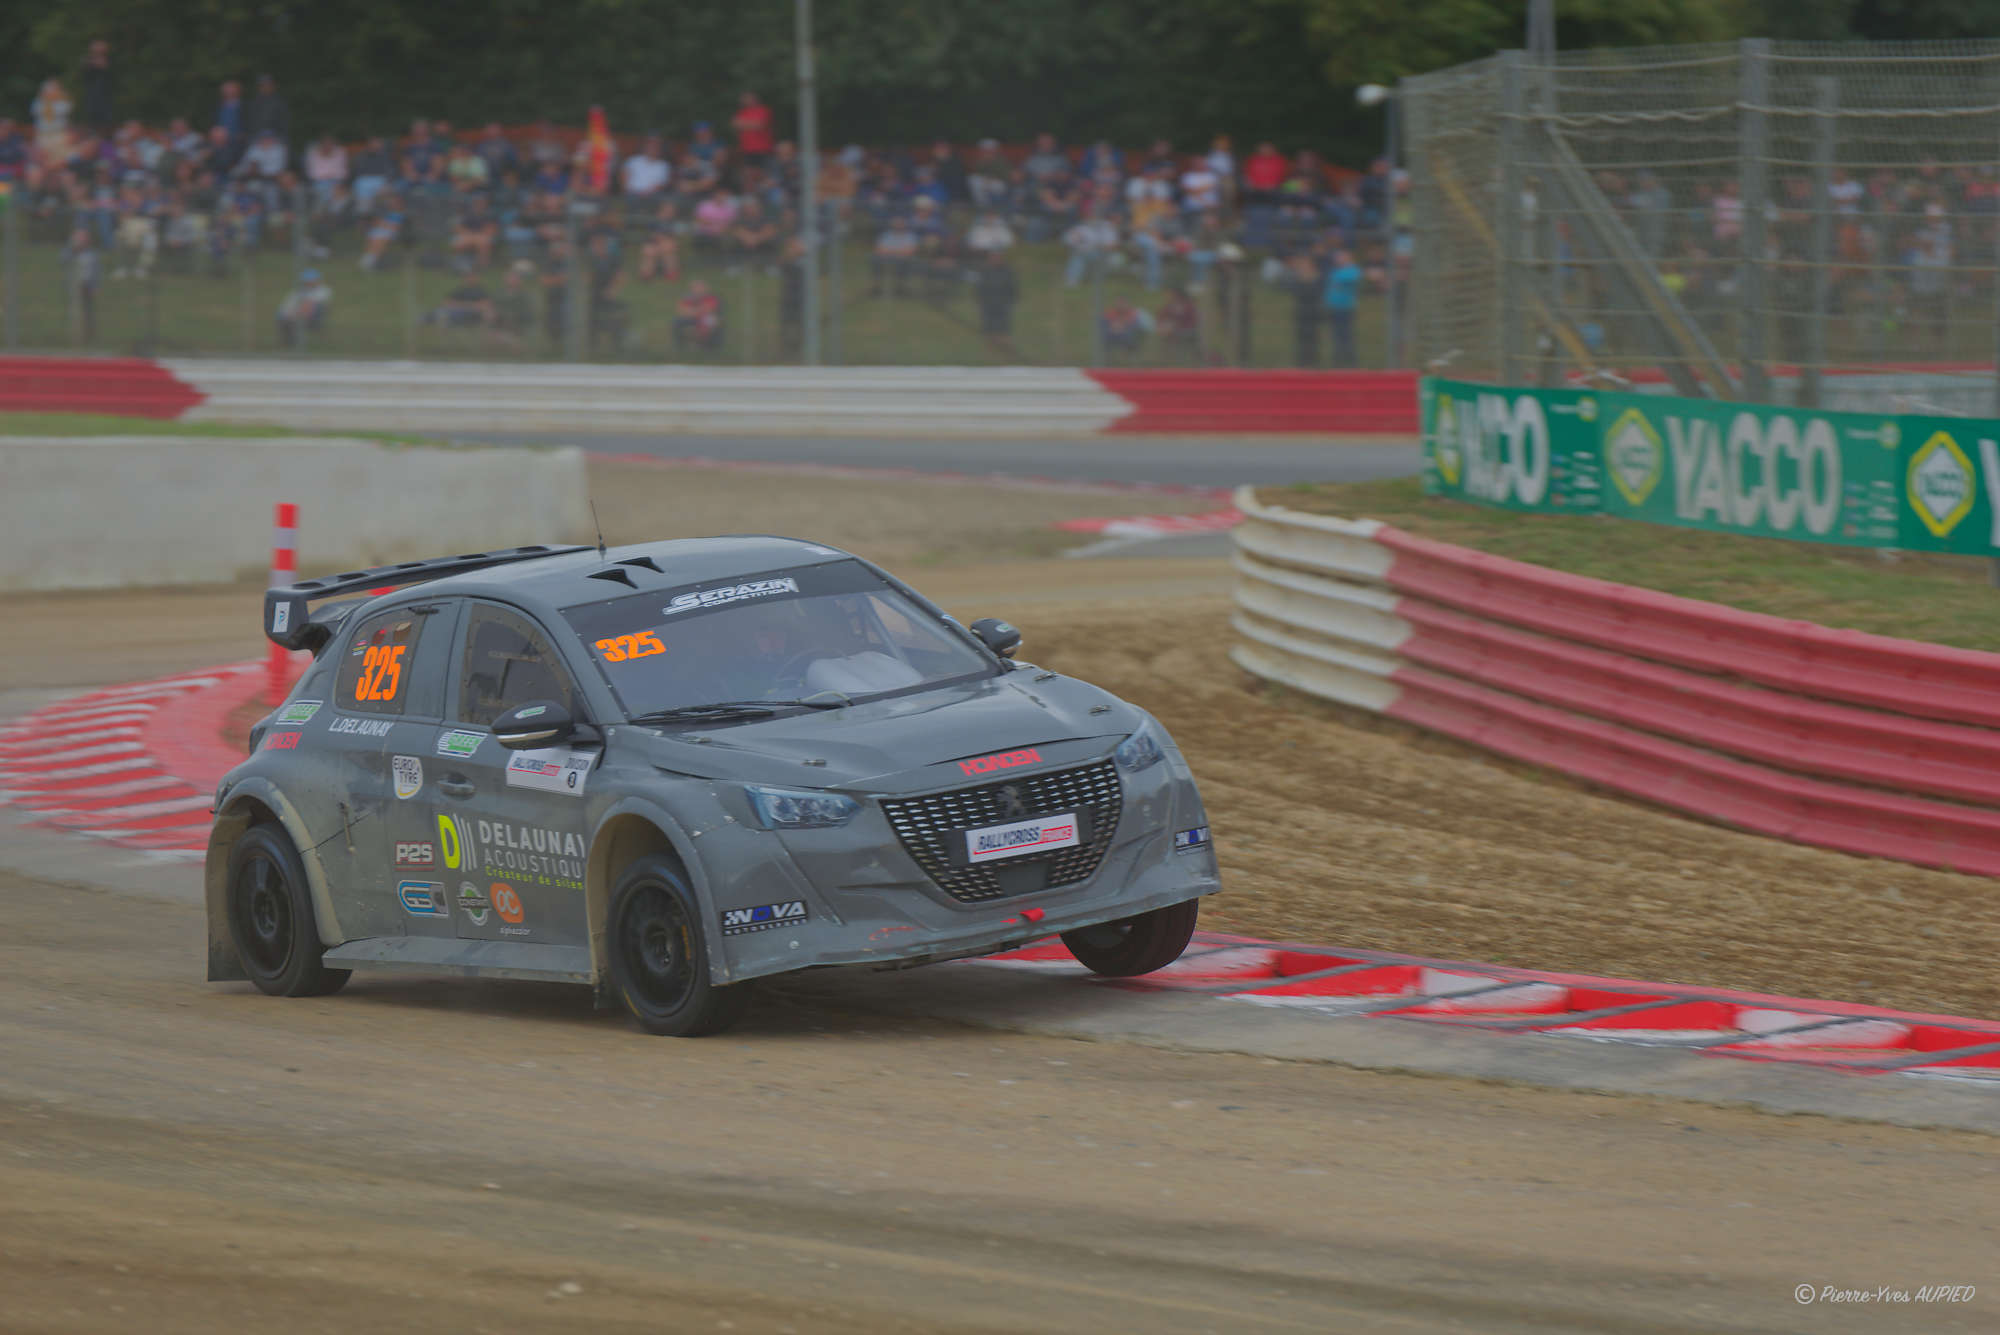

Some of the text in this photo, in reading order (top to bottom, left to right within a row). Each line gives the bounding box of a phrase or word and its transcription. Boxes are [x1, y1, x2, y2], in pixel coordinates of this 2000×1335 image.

[1666, 411, 1843, 536] YACCO
[663, 577, 799, 615] SERAZIN
[702, 588, 789, 608] COMPETITION
[595, 630, 667, 662] 325
[355, 645, 407, 701] 325
[328, 718, 394, 737] L.DELAUNAY
[958, 748, 1044, 776] HOWDEN
[399, 770, 418, 784] TYRE
[396, 843, 433, 863] P2S
[538, 874, 551, 887] de
